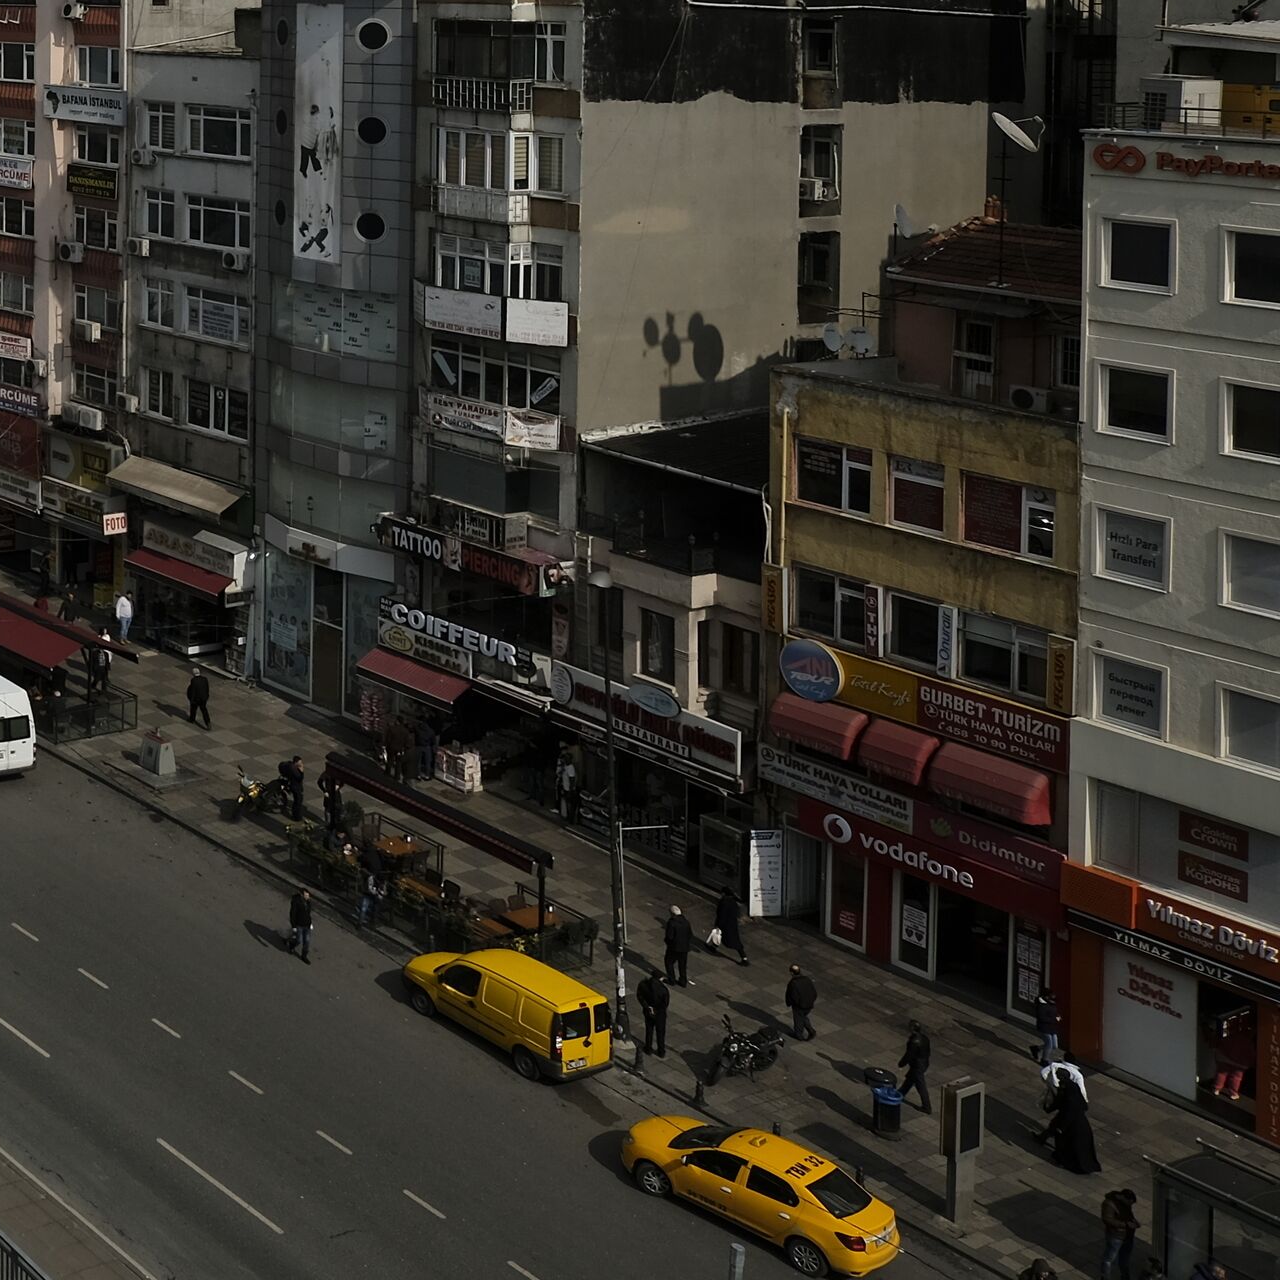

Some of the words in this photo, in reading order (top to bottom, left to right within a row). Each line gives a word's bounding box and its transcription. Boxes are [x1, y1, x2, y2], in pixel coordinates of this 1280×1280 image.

[62, 94, 88, 106] BAFANA
[89, 94, 122, 110] İSTANBUL
[456, 401, 499, 418] PARADISE
[105, 516, 127, 531] FOTO
[392, 525, 441, 560] TATTOO
[1110, 531, 1133, 546] Hızlı
[1136, 538, 1159, 552] Para
[1111, 548, 1156, 569] Transferi
[462, 547, 522, 586] PIERCING
[390, 603, 517, 666] COIFFEUR
[866, 614, 877, 648] THY
[939, 611, 951, 661] Onurair
[790, 671, 835, 686] TOUR
[1053, 651, 1067, 709] PEGASUS
[919, 685, 987, 719] GURBET
[1110, 687, 1155, 708] перевод
[1116, 703, 1146, 718] денег
[614, 719, 687, 756] RESTAURANT
[940, 707, 969, 729] TÜRK
[971, 719, 1002, 737] HAVA
[1006, 726, 1056, 754] YOLLARI
[974, 733, 988, 745] 10
[989, 739, 1007, 751] 90
[775, 752, 811, 775] TÜRK
[813, 767, 848, 790] HAVA
[850, 781, 908, 811] YOLLARI
[1190, 827, 1238, 853] Crown
[1202, 825, 1238, 842] Golden
[859, 832, 975, 889] vodafone
[958, 830, 1046, 872] Didimtur
[1184, 866, 1241, 894] Корона
[1146, 898, 1215, 940] Yılmaz
[1114, 931, 1171, 960] YILMAZ
[1184, 957, 1234, 982] DÖVİZ
[785, 1161, 812, 1180] TBM
[805, 1154, 826, 1169] 32
